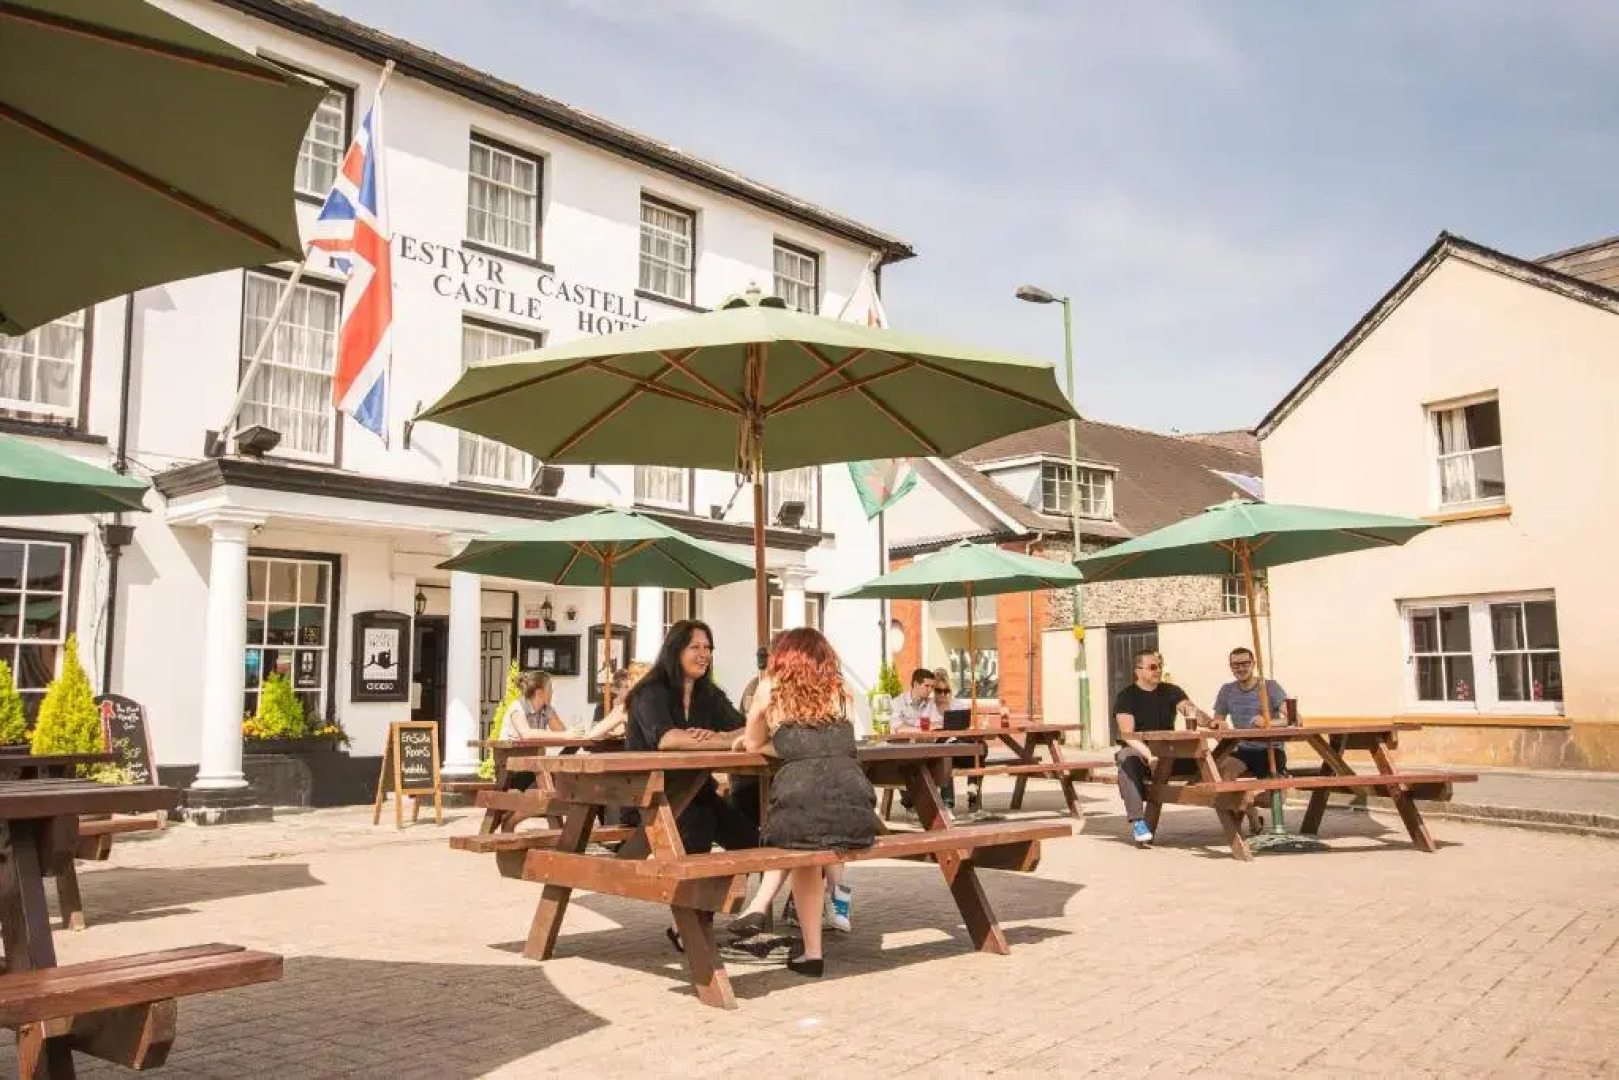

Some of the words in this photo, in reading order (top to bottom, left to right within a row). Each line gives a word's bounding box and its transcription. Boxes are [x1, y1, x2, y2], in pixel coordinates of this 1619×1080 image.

[390, 232, 505, 284] ESTY'R
[537, 274, 647, 321] CASTELL
[433, 273, 541, 320] CASTLE
[578, 310, 640, 335] HOT
